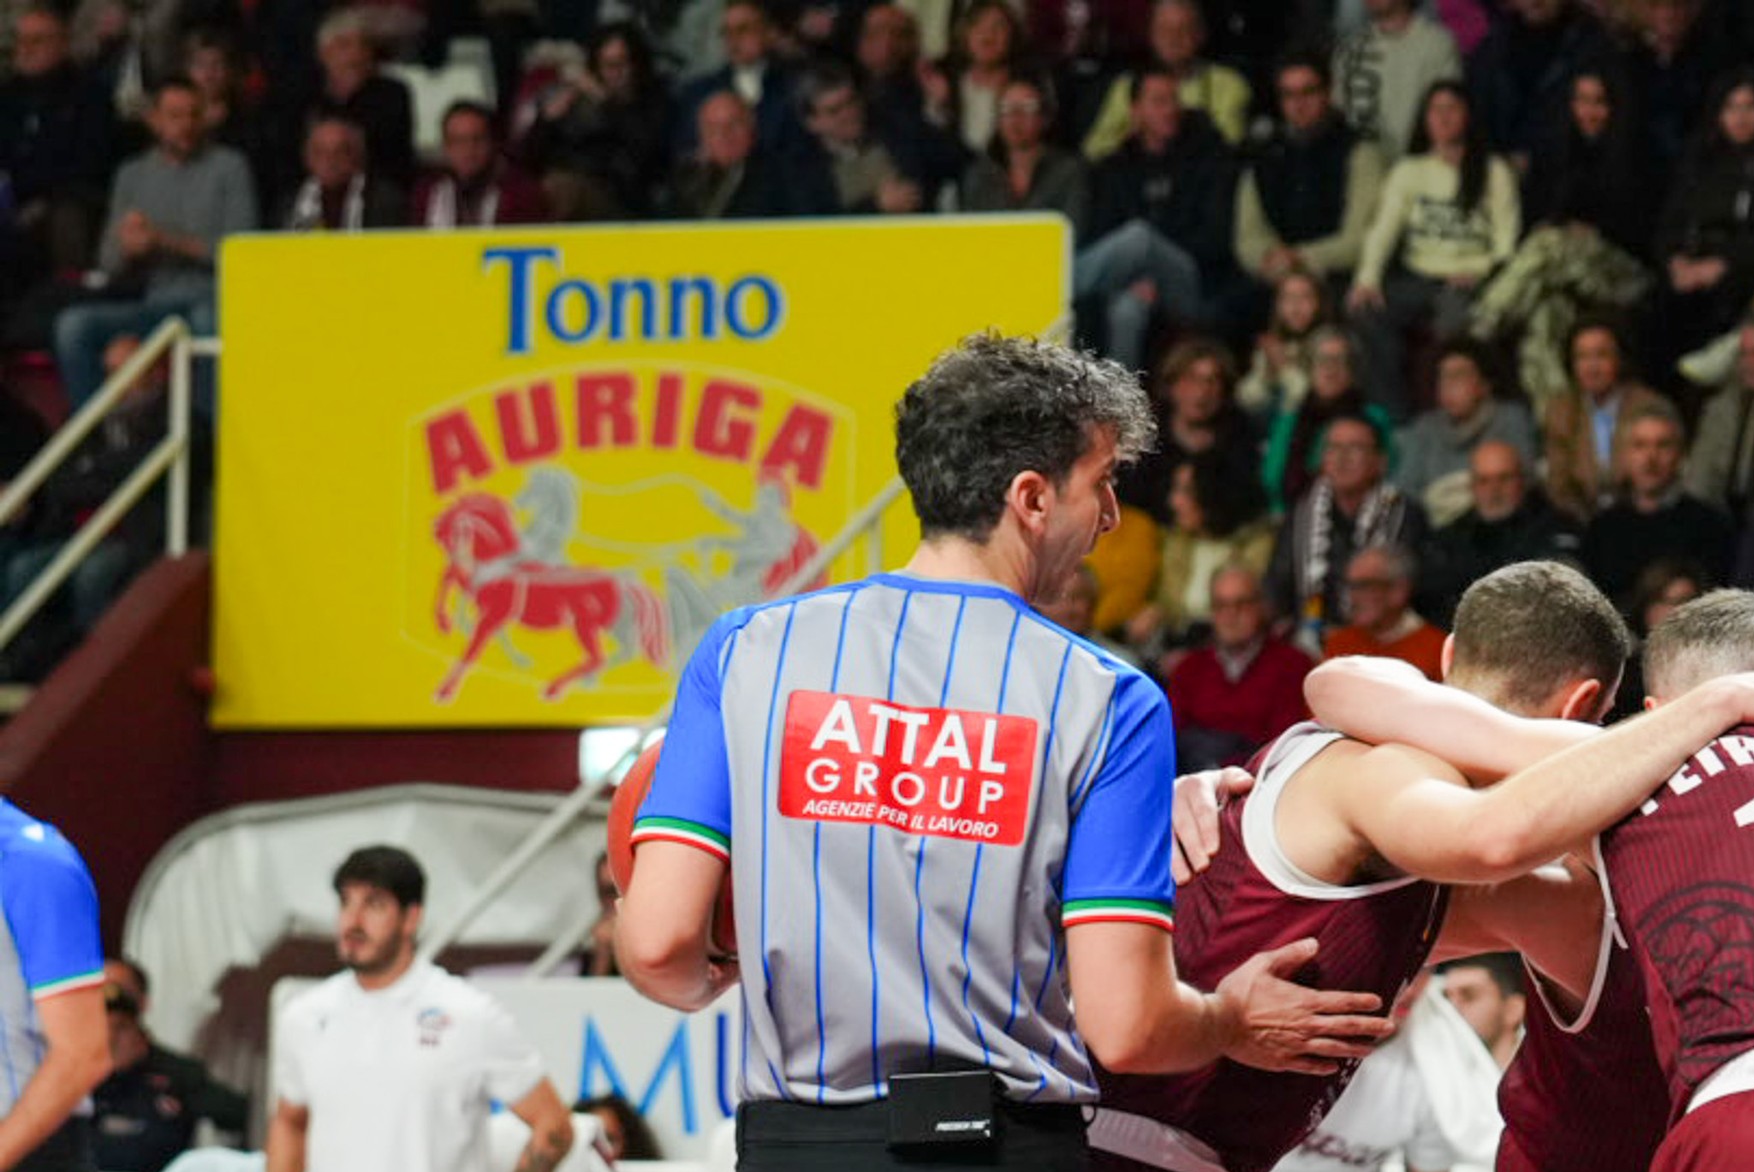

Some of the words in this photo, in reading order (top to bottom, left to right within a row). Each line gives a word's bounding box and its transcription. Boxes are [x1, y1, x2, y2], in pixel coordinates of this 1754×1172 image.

[482, 245, 783, 356] Tonno
[426, 370, 833, 496] AURIGA
[810, 699, 1008, 775] ATTAL
[802, 799, 876, 820] AGENZIE
[877, 806, 907, 828] PER
[910, 814, 925, 831] IL
[928, 818, 1000, 839] LAVORO
[804, 757, 1005, 816] GROUP
